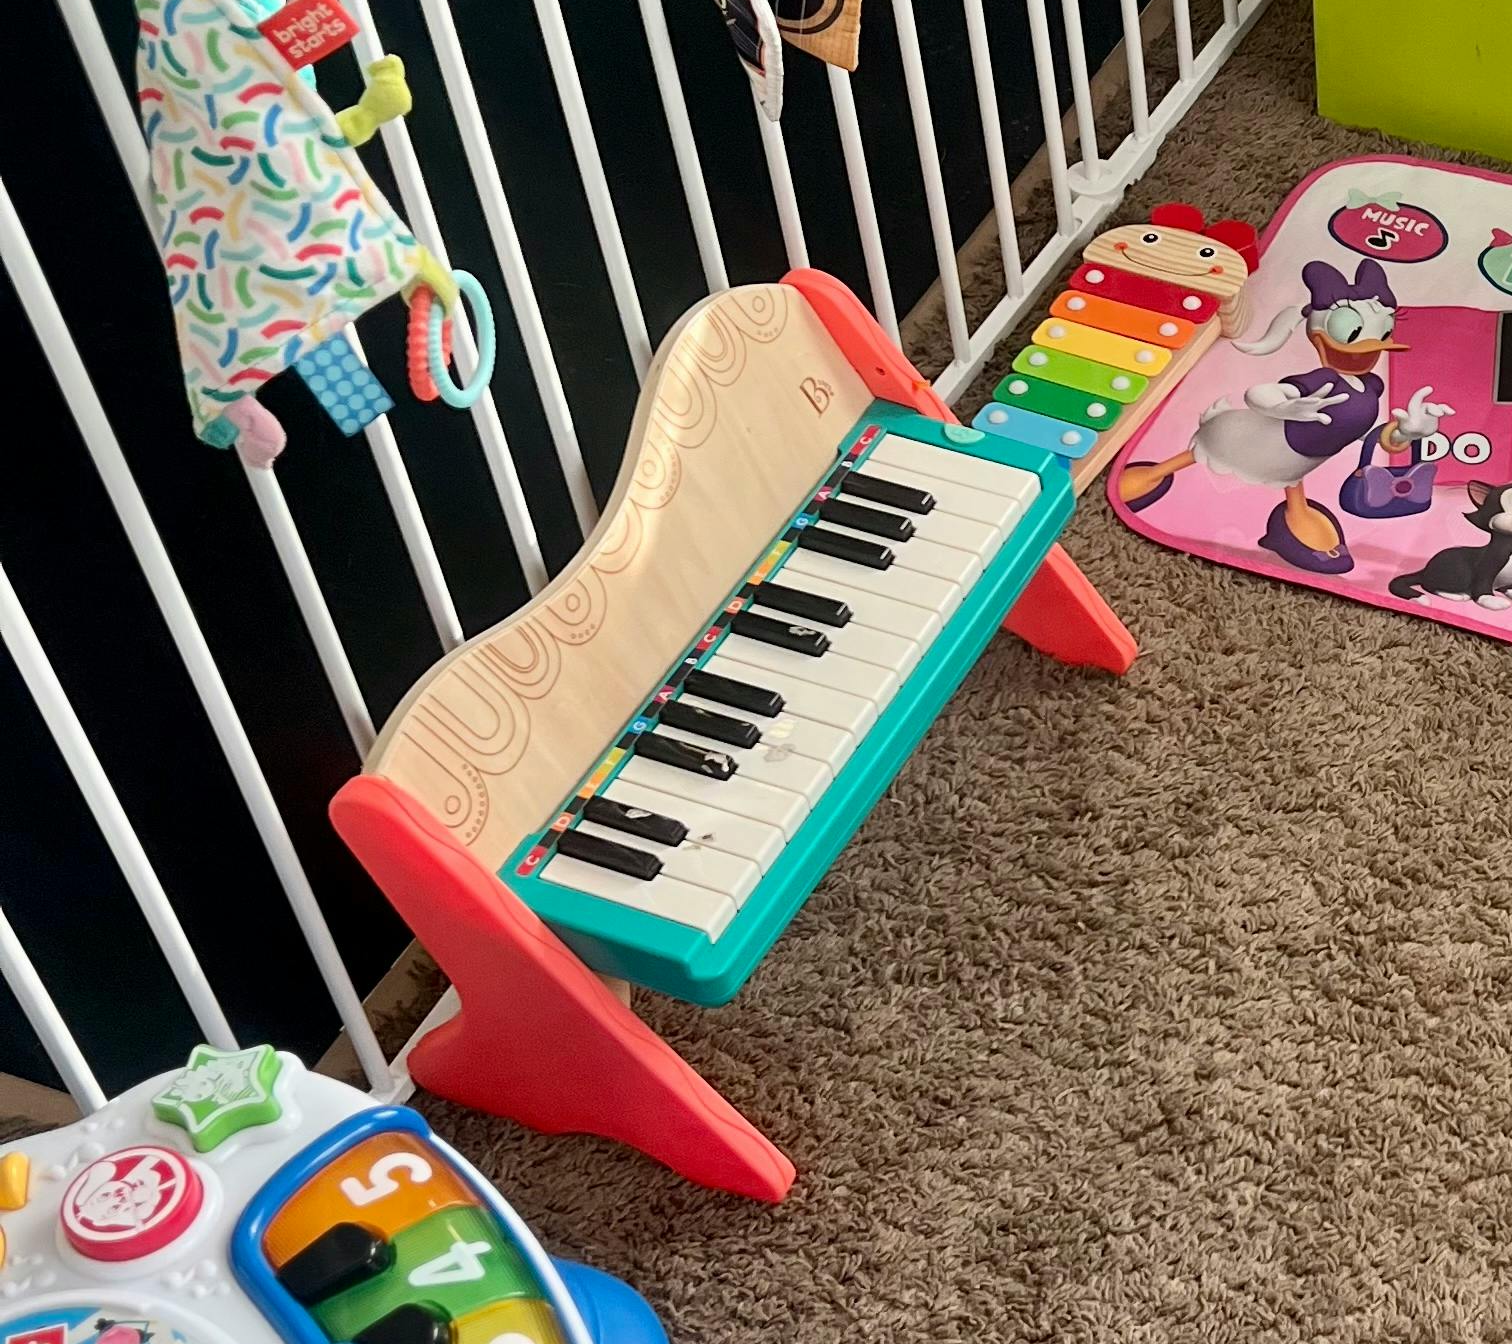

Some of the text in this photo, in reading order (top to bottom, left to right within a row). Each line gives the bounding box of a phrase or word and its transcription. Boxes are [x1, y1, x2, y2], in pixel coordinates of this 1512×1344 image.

[272, 3, 334, 44] bright
[288, 18, 347, 59] starts
[1361, 208, 1430, 237] MUSIC
[1420, 430, 1492, 464] DO
[818, 491, 831, 500] A
[729, 601, 742, 611] D
[704, 633, 716, 643] C
[659, 691, 672, 701] A
[526, 855, 540, 865] C
[341, 1152, 432, 1207] 5
[408, 1240, 492, 1287] 4
